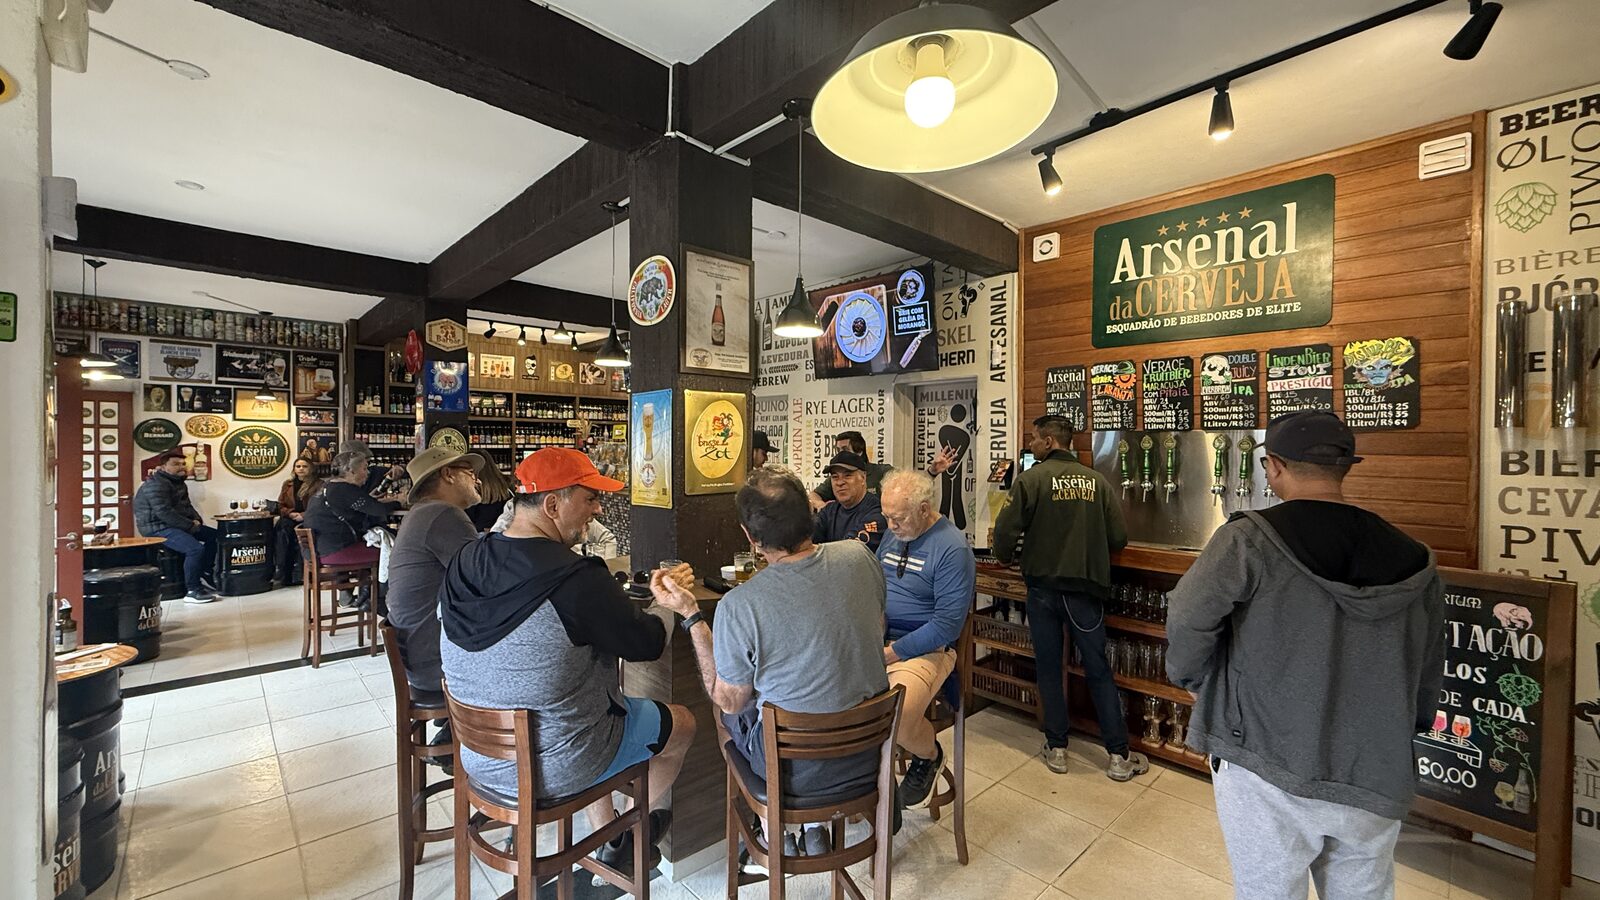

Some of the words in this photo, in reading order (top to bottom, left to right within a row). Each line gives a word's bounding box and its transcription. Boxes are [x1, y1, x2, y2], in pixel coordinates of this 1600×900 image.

[1500, 94, 1600, 136] BEER
[1497, 136, 1566, 172] ØL
[1110, 202, 1299, 284] Arsenal
[1494, 246, 1600, 275] BIÈRE
[1106, 318, 1161, 334] ESQUADRÃO
[1164, 317, 1177, 326] DE
[1180, 309, 1243, 325] BEBEDORES
[1247, 306, 1262, 316] DE
[1265, 302, 1302, 315] ELITE
[938, 325, 976, 346] SKEL
[761, 350, 809, 364] LEVEDURA
[1228, 353, 1256, 364] DOUBLE
[1143, 358, 1185, 374] VERACE
[1268, 362, 1331, 378] STOUT
[757, 374, 790, 387] EBREW
[1047, 369, 1085, 384] Arsenal
[1144, 368, 1191, 384] FRUITBIER
[1390, 374, 1415, 388] IPA
[1143, 379, 1186, 391] MARACUJÁ
[920, 389, 977, 402] MILLENIU
[755, 400, 788, 415] QUINO
[793, 398, 802, 424] ALE
[806, 401, 827, 415] RYE
[832, 397, 874, 413] LAGER
[814, 416, 874, 428] RAUCHWEIZEN
[927, 407, 935, 465] METTE
[234, 445, 278, 457] Arsenal
[793, 428, 802, 474] MPKIN
[813, 430, 821, 478] KÖLSCH
[965, 477, 976, 492] OP
[1051, 476, 1096, 491] Arsenal
[231, 546, 266, 558] Arsenal
[1444, 593, 1482, 609] RIUM
[1445, 620, 1544, 661] TAÇÃO
[1444, 660, 1487, 684] LOS
[1472, 698, 1536, 725] CADA.
[1418, 756, 1477, 789] 60,00
